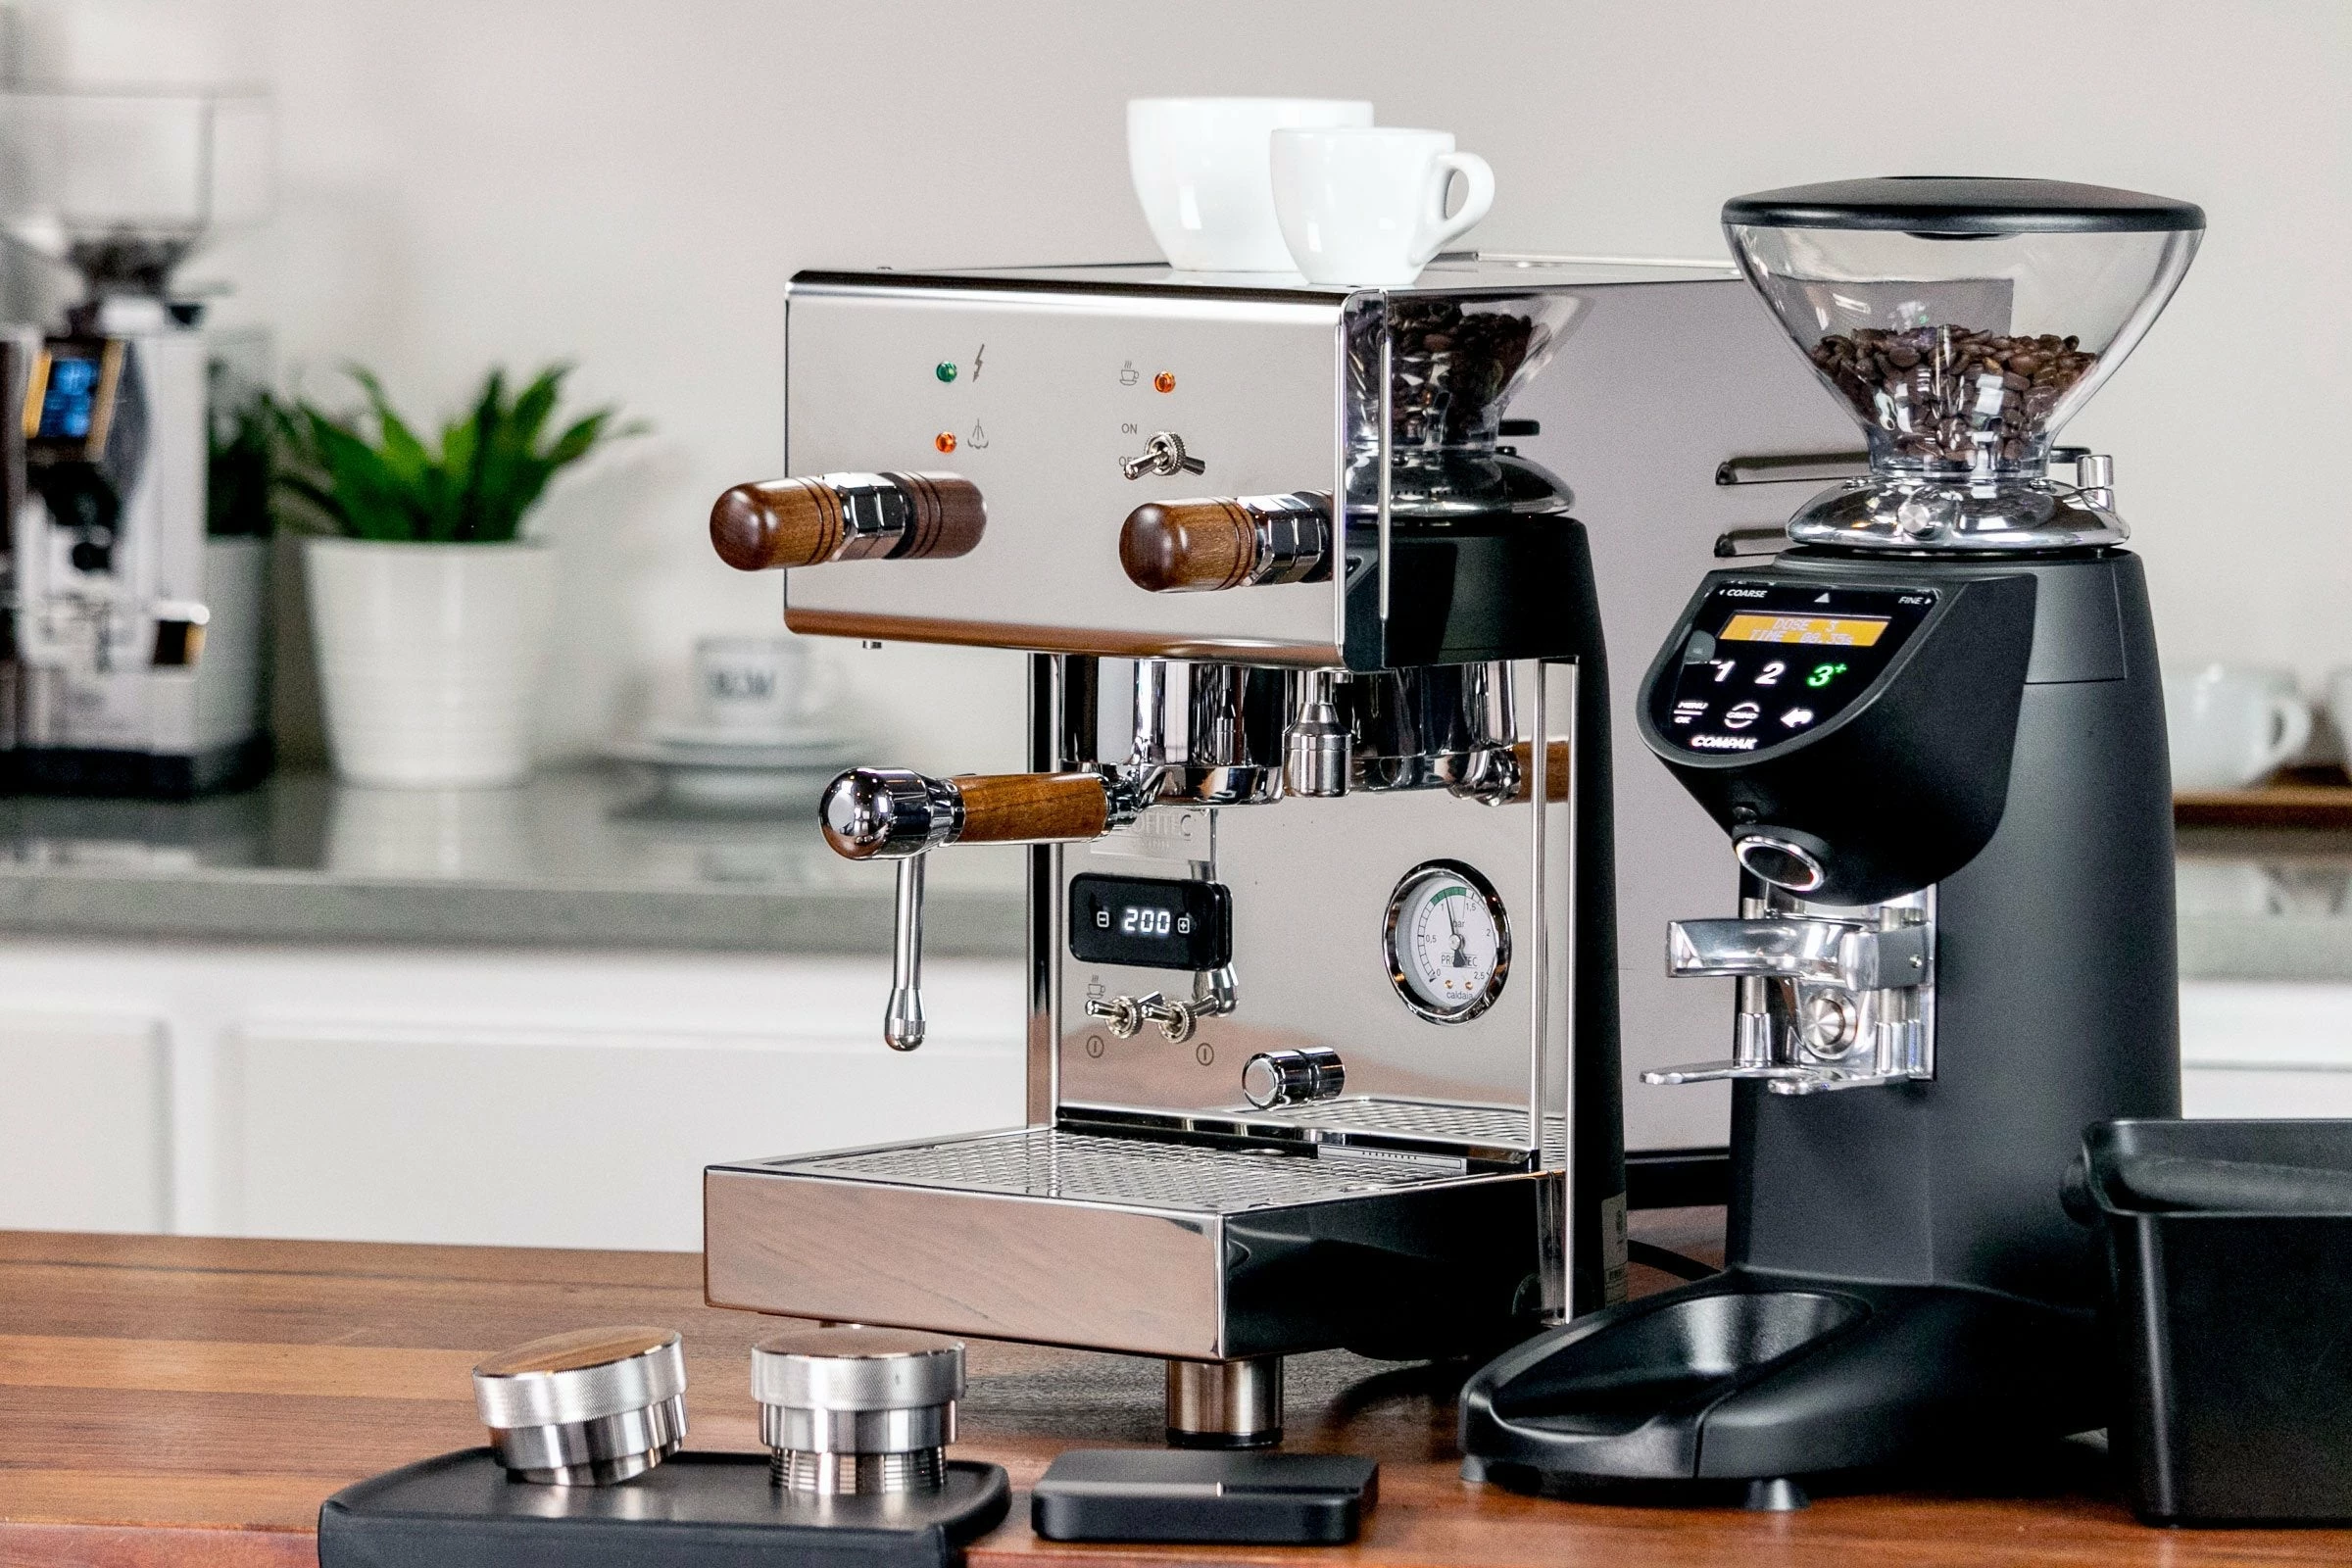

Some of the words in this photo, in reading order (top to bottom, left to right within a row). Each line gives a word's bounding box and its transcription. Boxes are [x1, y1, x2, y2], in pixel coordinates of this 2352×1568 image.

[1121, 423, 1138, 434] ON
[1118, 456, 1139, 467] OF
[1727, 589, 1768, 598] COARSE
[1898, 596, 1924, 605] FINE
[1773, 617, 1814, 632] DOSE
[1754, 662, 1786, 685] 2
[1678, 702, 1709, 710] MENU
[1690, 736, 1758, 750] COMPAK
[1465, 903, 1477, 911] 1,5
[1123, 908, 1171, 933] 200
[1426, 935, 1437, 944] 0,5
[1474, 971, 1486, 980] 2,5
